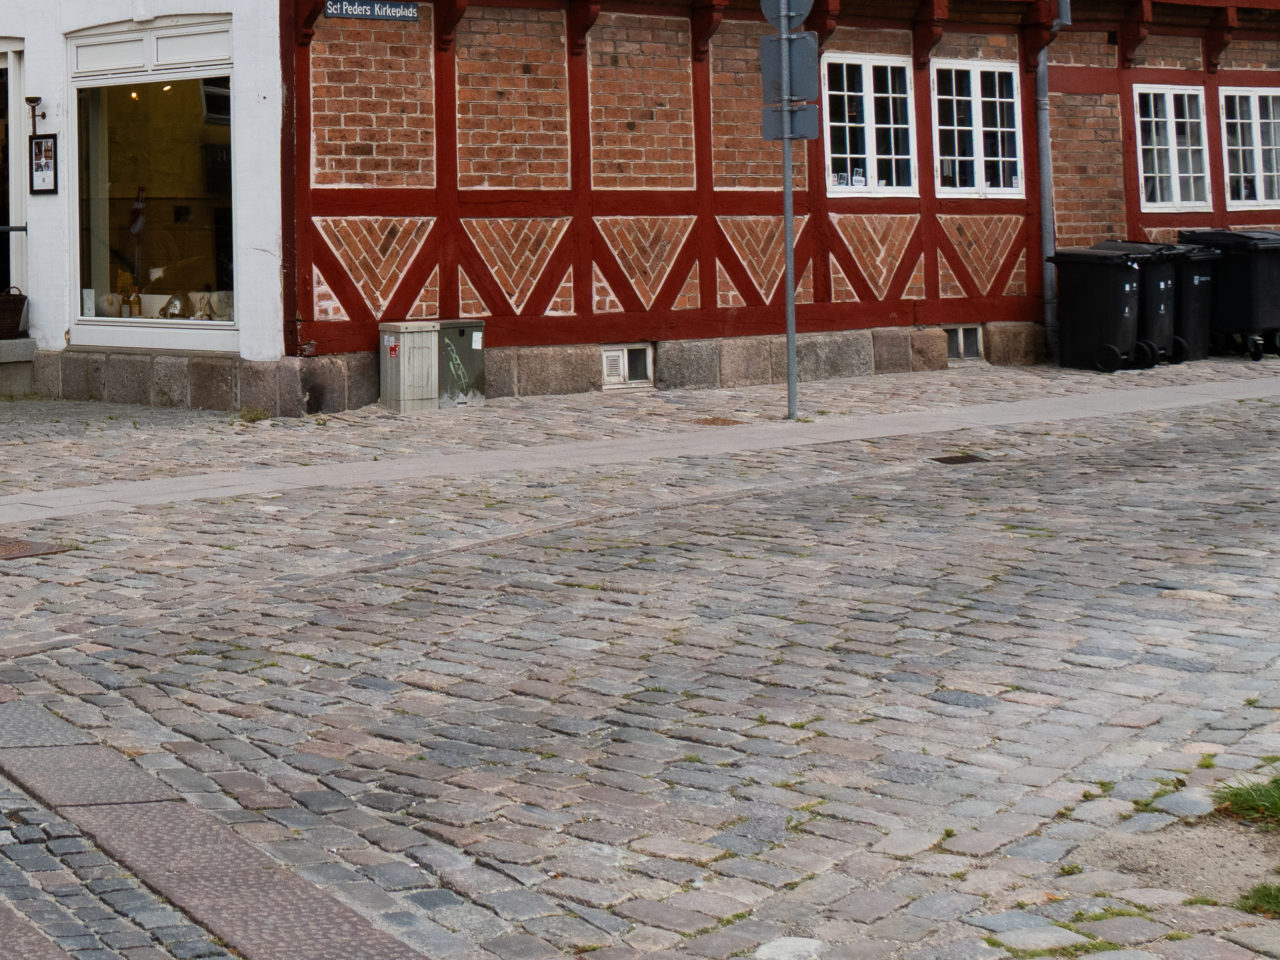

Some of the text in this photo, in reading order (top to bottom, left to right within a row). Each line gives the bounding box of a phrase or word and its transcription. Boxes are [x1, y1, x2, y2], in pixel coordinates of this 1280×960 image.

[327, 1, 418, 18] Sct Peders Kirkeplads
